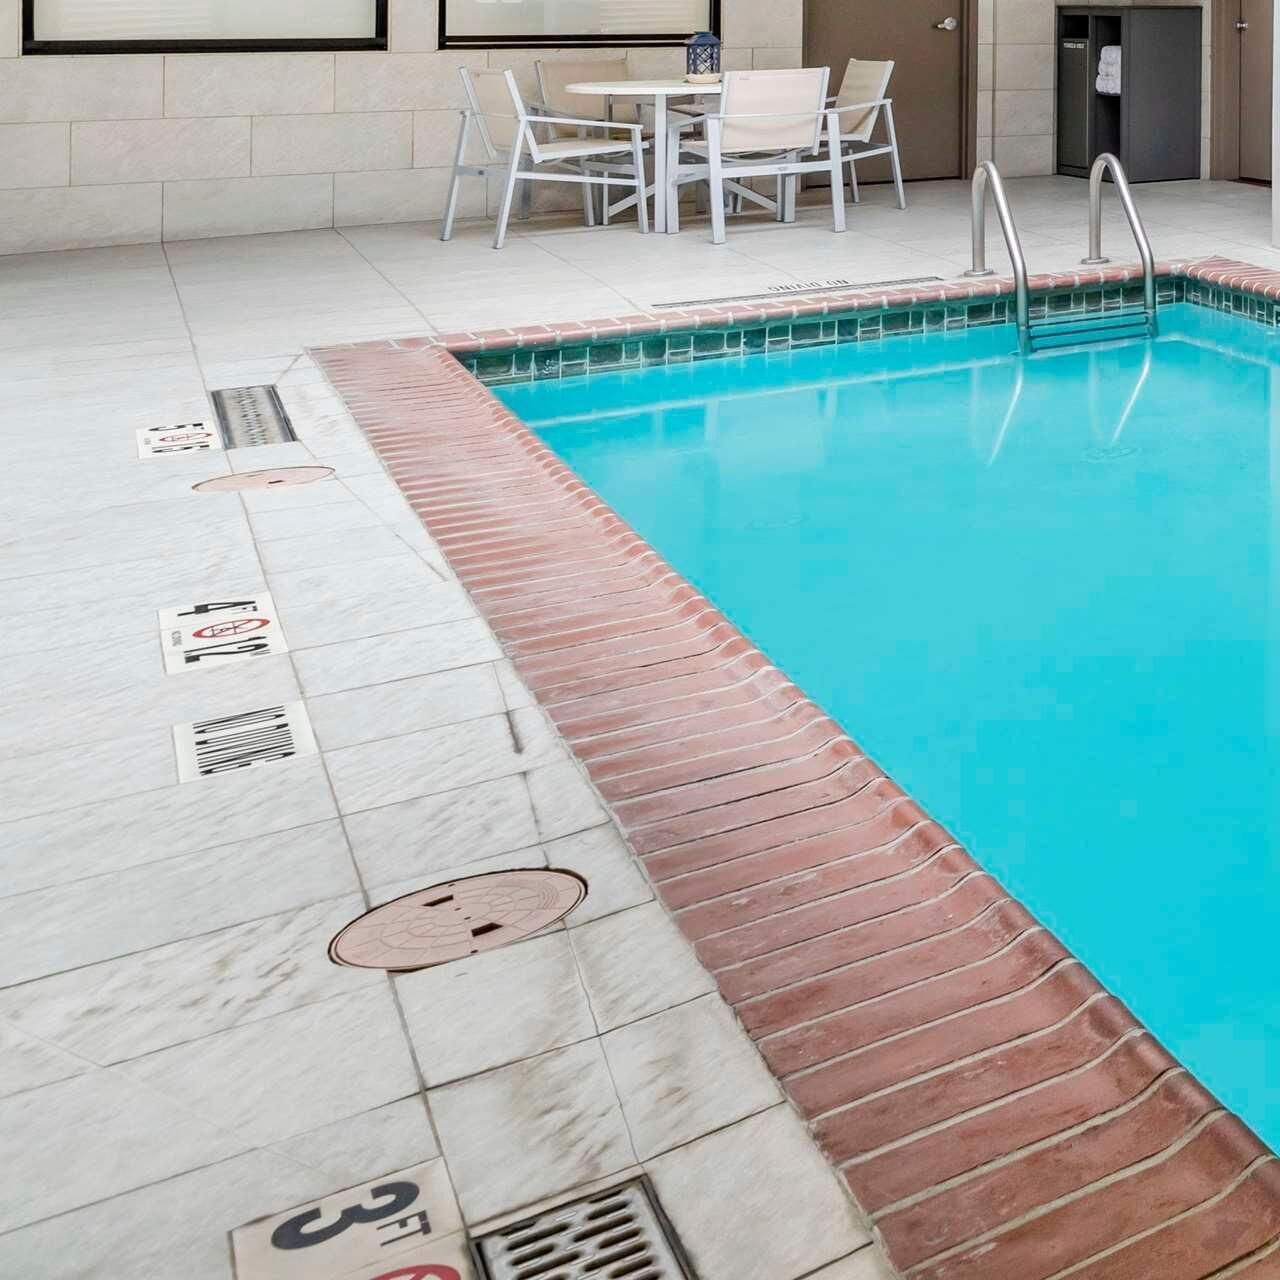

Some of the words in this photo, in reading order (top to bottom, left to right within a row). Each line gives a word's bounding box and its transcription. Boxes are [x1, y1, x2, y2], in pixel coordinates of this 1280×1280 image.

[177, 601, 256, 616] 4
[192, 705, 286, 735] NO
[195, 723, 296, 776] DIVING
[271, 1181, 420, 1250] 3
[376, 1209, 432, 1247] FT
